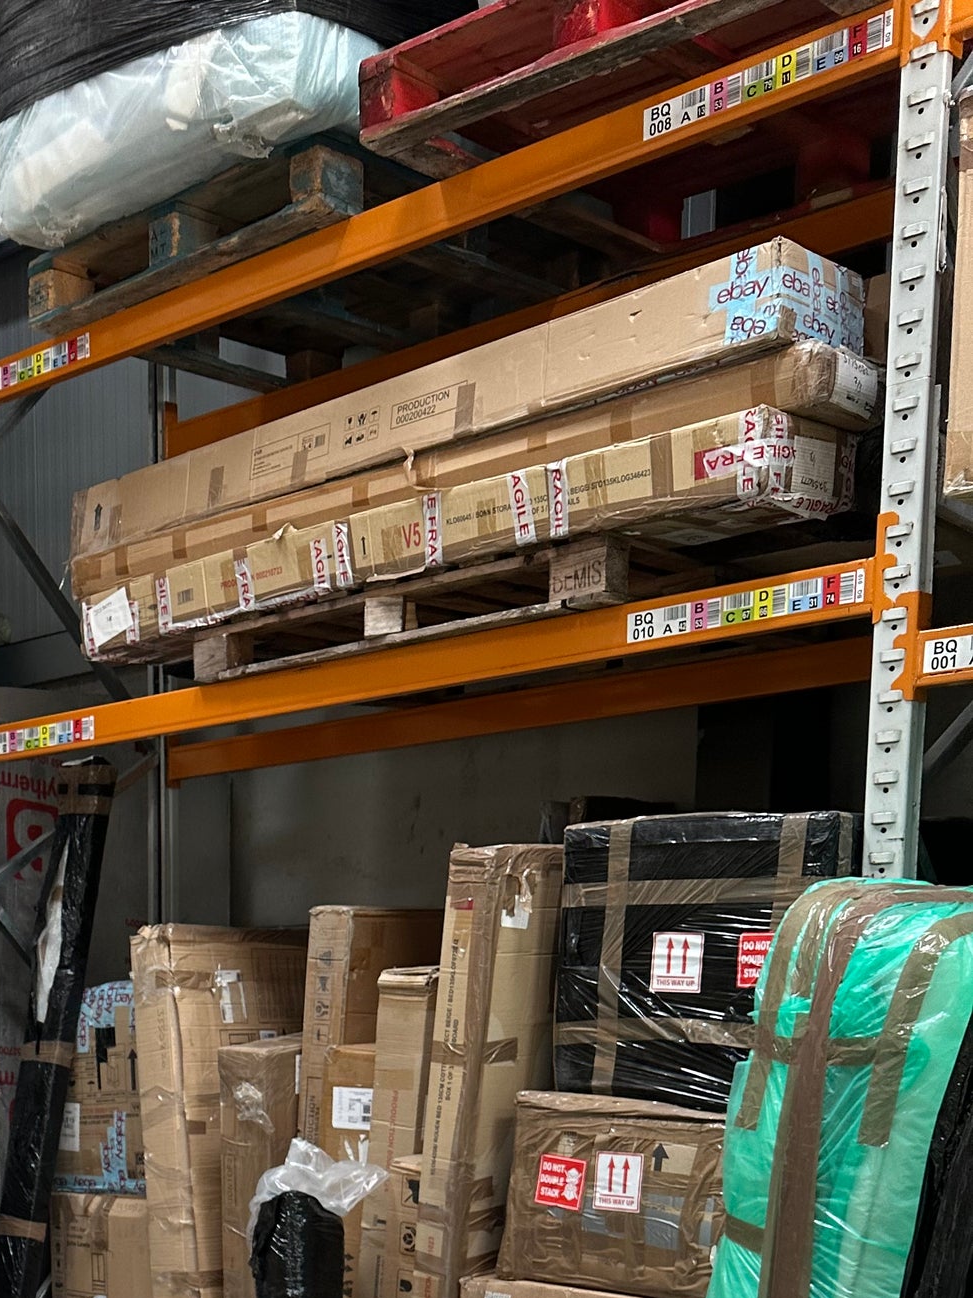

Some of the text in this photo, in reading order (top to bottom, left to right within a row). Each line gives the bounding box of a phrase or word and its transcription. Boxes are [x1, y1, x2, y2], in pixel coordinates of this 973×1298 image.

[853, 25, 863, 38] F
[781, 55, 792, 68] D
[817, 58, 826, 70] E
[714, 82, 724, 94] B
[746, 85, 757, 98] C
[650, 103, 671, 121] BQ
[649, 118, 671, 136] 008
[680, 111, 691, 124] A
[717, 276, 770, 304] ebay
[782, 271, 811, 297] eba
[730, 316, 767, 338] eba
[36, 353, 42, 362] D
[53, 358, 58, 367] E
[3, 366, 8, 375] B
[19, 371, 25, 380] C
[397, 390, 450, 414] PRODUCTION
[395, 405, 435, 424] 000200422
[511, 475, 530, 537] AGILE
[402, 522, 422, 549] V5
[826, 577, 835, 588] F
[759, 590, 769, 602] D
[694, 602, 704, 613] B
[792, 597, 818, 611] E 31
[634, 612, 654, 627] BQ
[725, 612, 735, 623] C
[633, 626, 654, 640] 010
[662, 623, 673, 635] A
[933, 639, 958, 654] BQ
[931, 655, 957, 670] 001
[743, 941, 770, 950] DO NOT
[741, 955, 765, 964] DOUBL
[671, 979, 685, 987] WAY
[542, 1162, 565, 1173] DO NOT
[540, 1174, 564, 1186] DOUBLE
[540, 1187, 559, 1198] STACK
